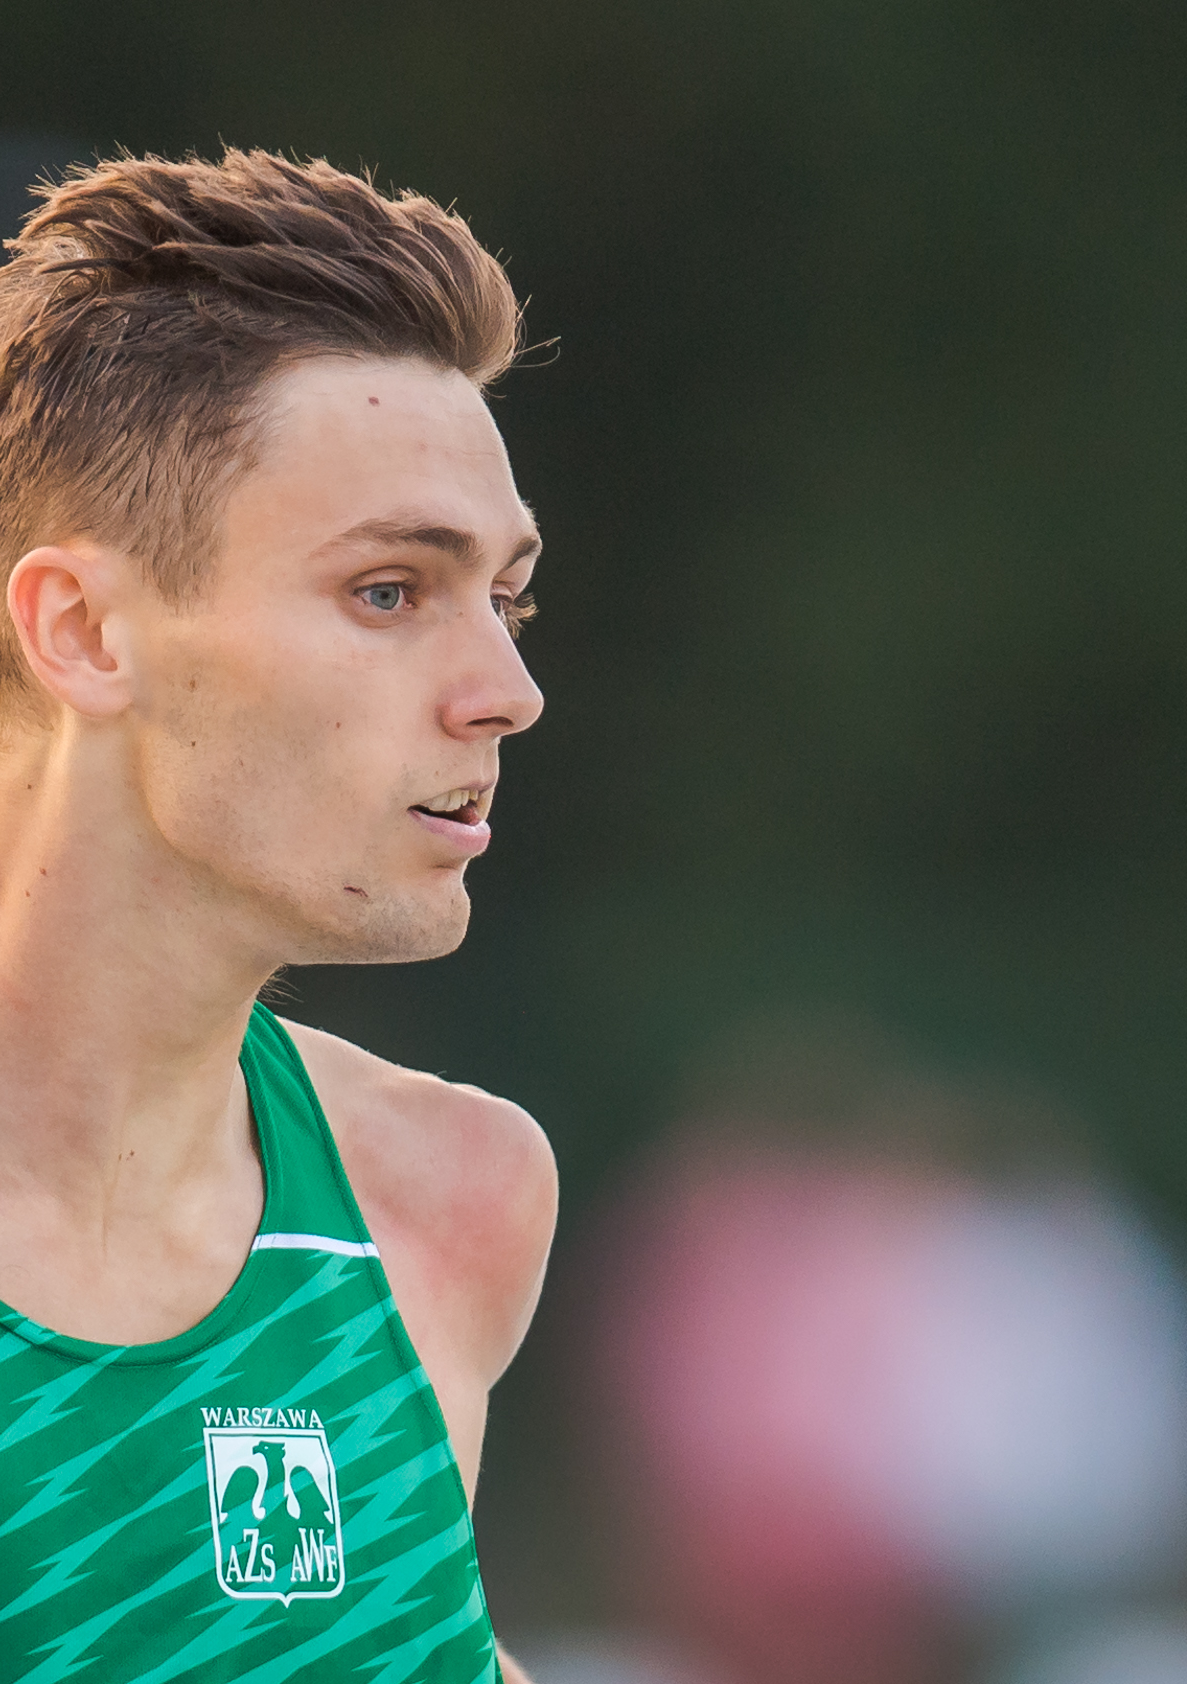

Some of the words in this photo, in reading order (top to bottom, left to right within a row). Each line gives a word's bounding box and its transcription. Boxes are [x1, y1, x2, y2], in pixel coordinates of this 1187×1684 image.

[200, 1407, 324, 1428] WARSZAWA
[225, 1528, 276, 1583] AZS
[290, 1527, 338, 1582] AWF
